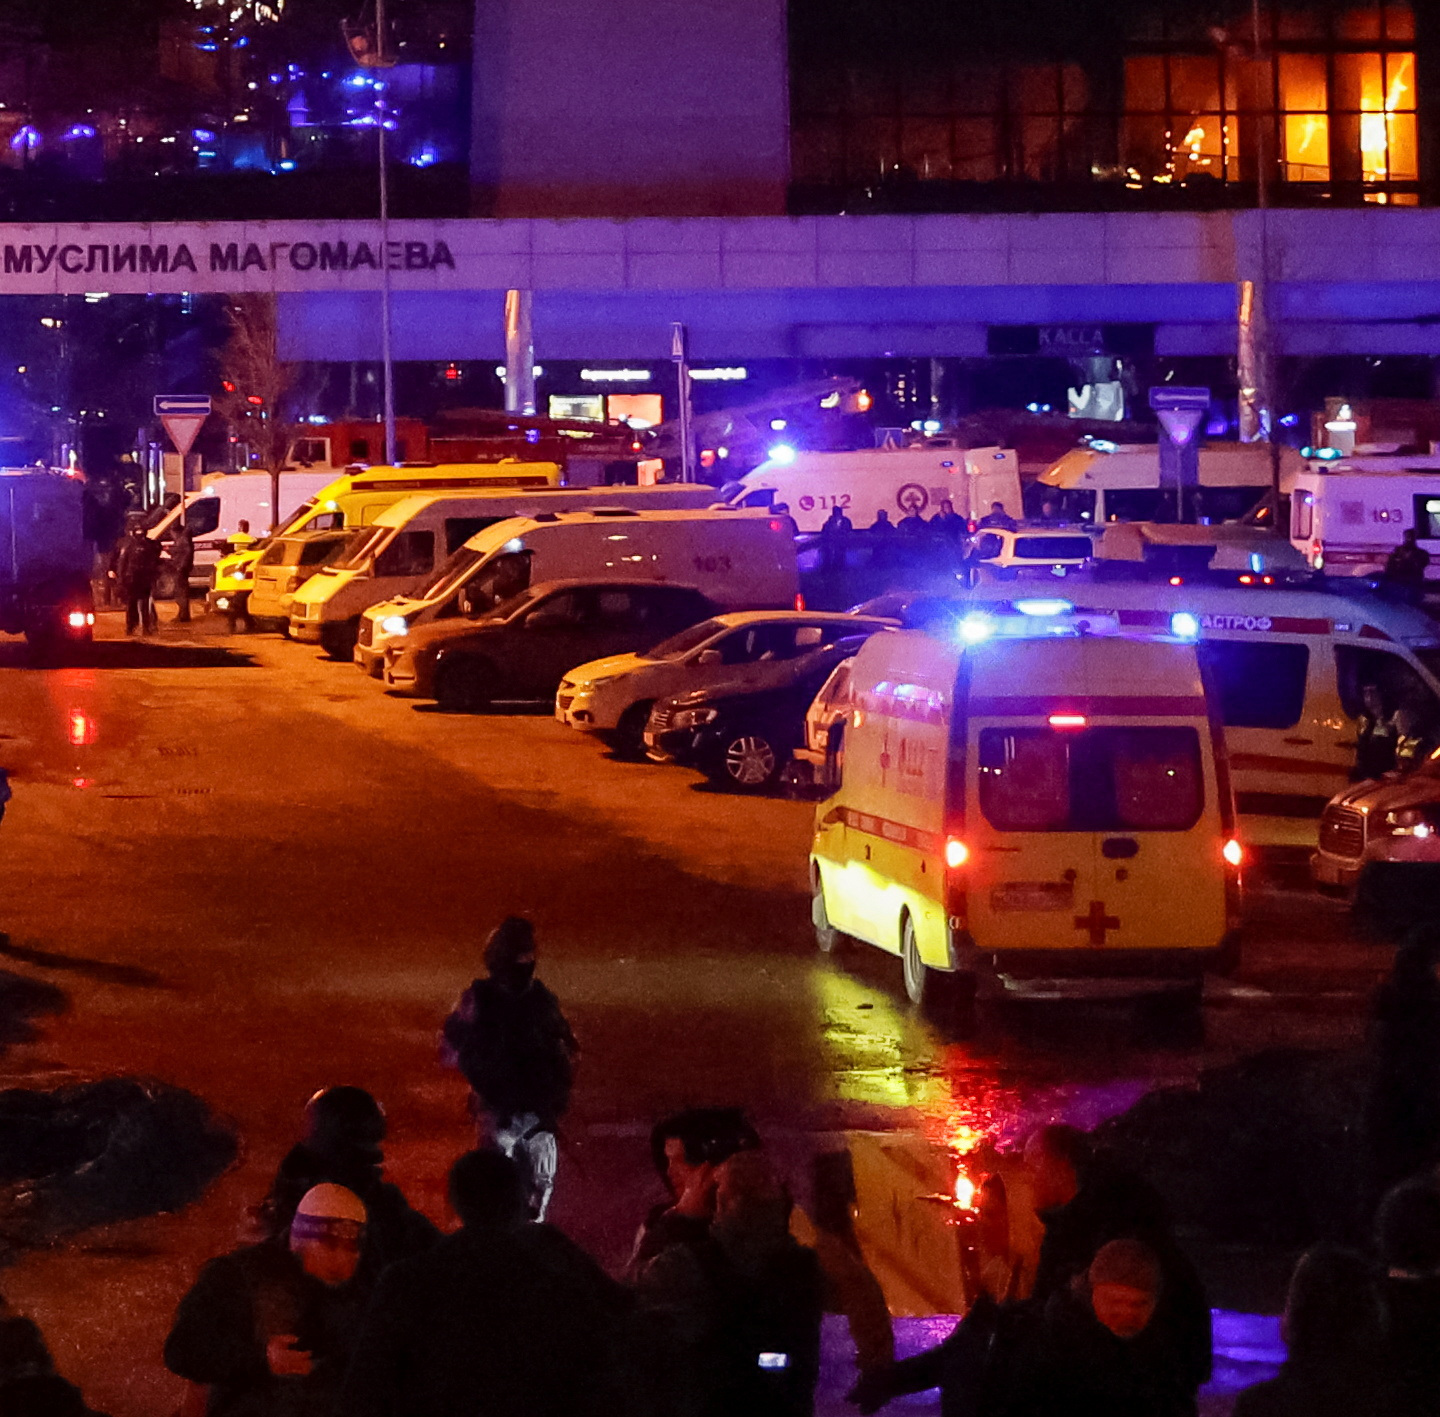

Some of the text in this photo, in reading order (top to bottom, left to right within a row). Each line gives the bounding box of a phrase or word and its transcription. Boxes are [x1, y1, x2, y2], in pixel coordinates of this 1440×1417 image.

[4, 243, 197, 274] МУСЛИМА
[209, 241, 456, 271] МАГОМАЕВА
[818, 494, 851, 510] 112
